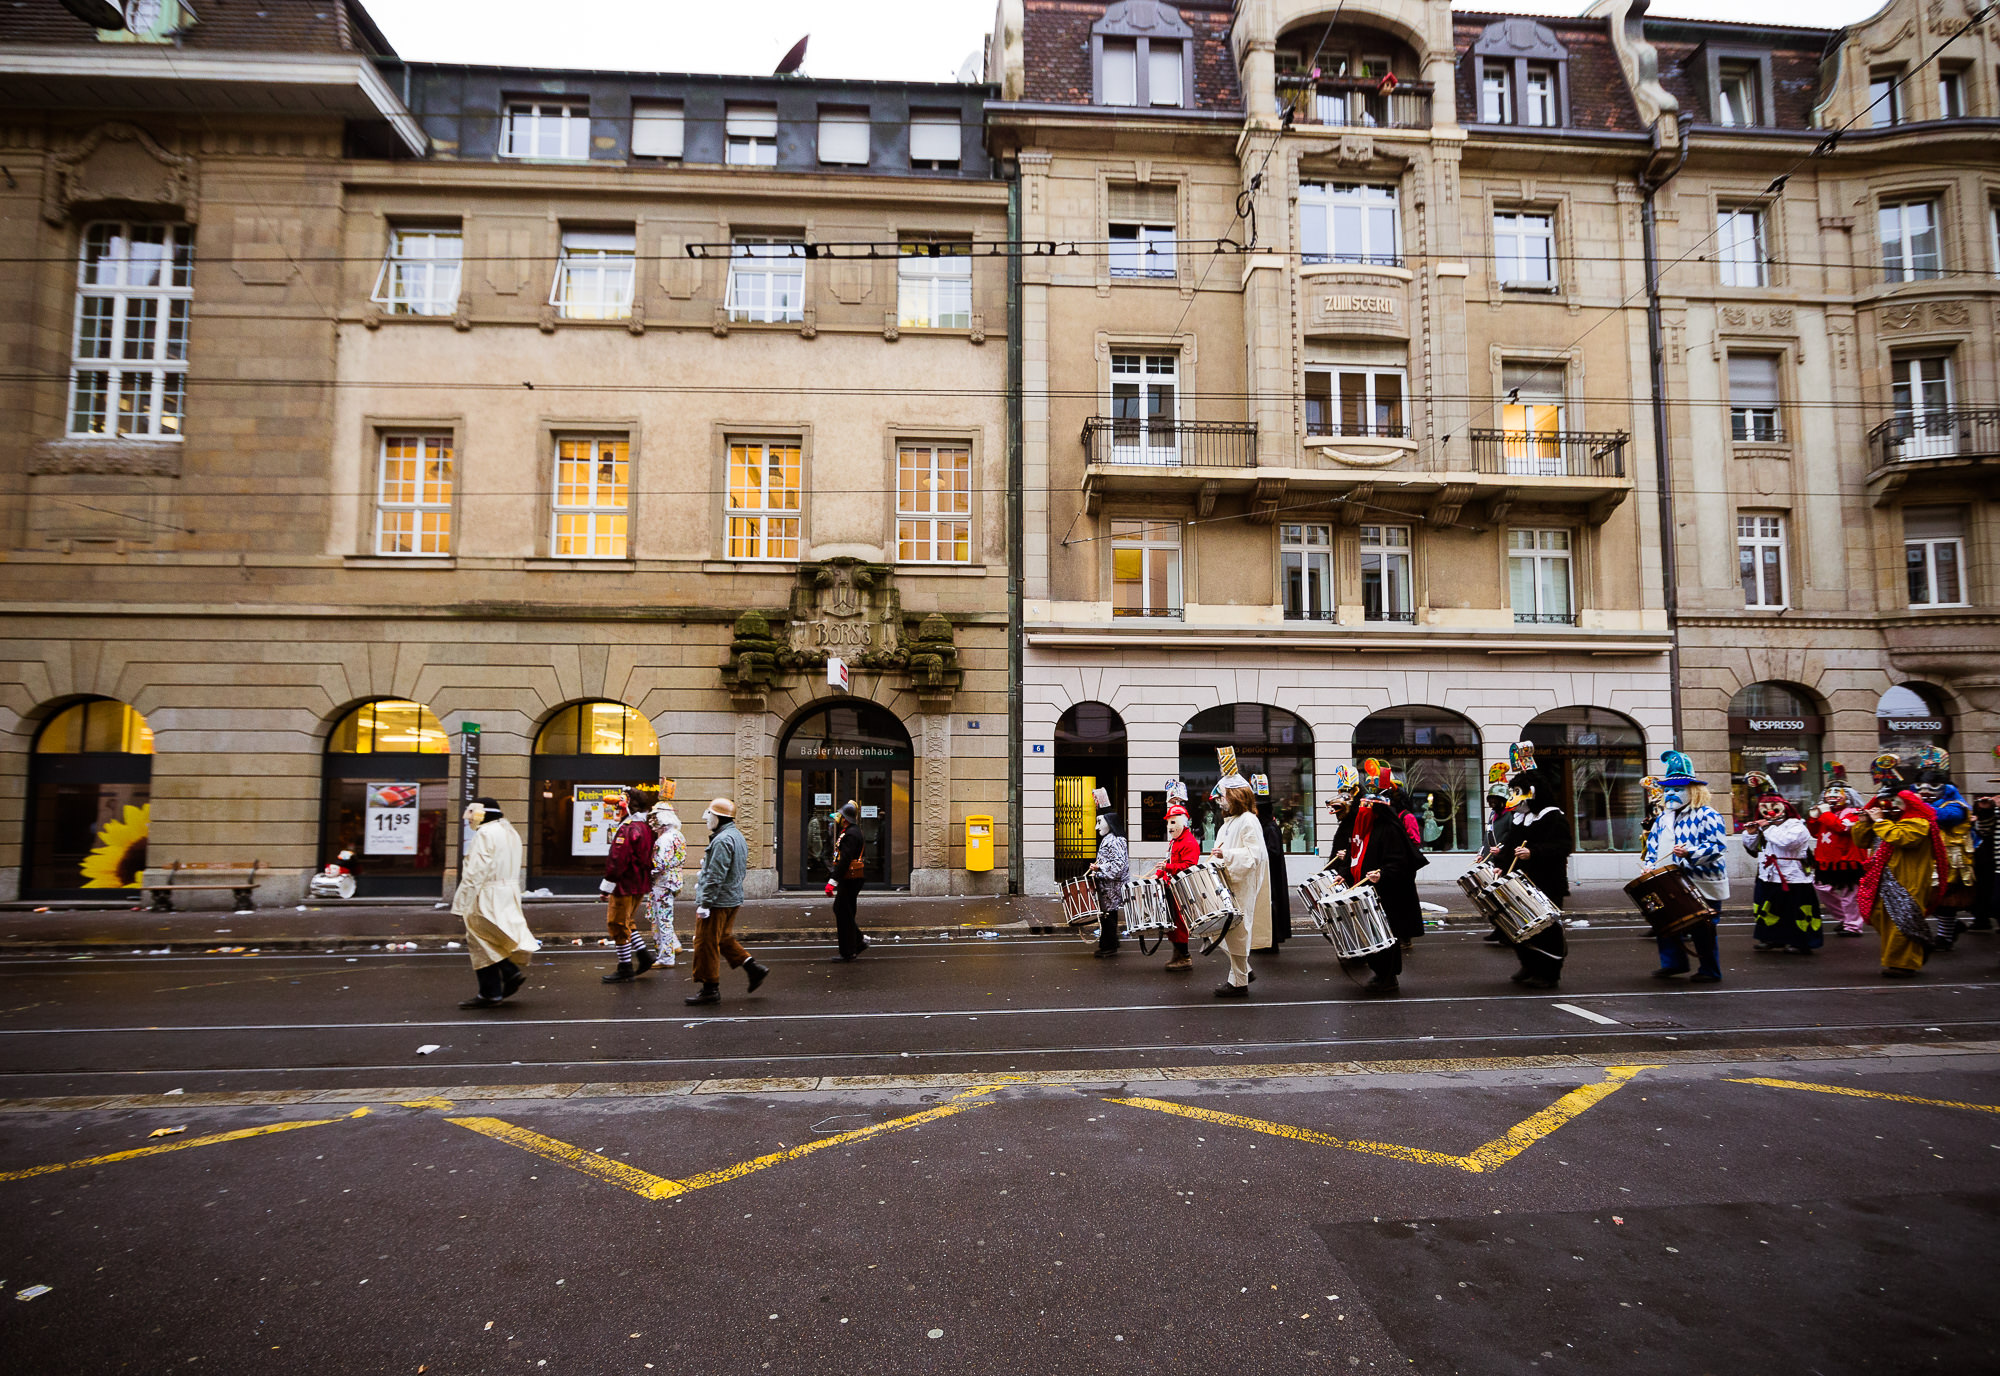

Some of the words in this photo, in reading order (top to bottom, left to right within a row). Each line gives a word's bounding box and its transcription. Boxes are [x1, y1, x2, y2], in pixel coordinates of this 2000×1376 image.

[816, 622, 872, 646] BÖRSE
[1748, 719, 1804, 731] NESPRESSO
[1887, 719, 1942, 731] NESPRESSO
[800, 746, 831, 756] Basler
[835, 746, 894, 756] Medienhaus
[1392, 747, 1405, 755] Das
[1407, 747, 1452, 755] Schokoladen
[1454, 747, 1476, 755] Kaffee
